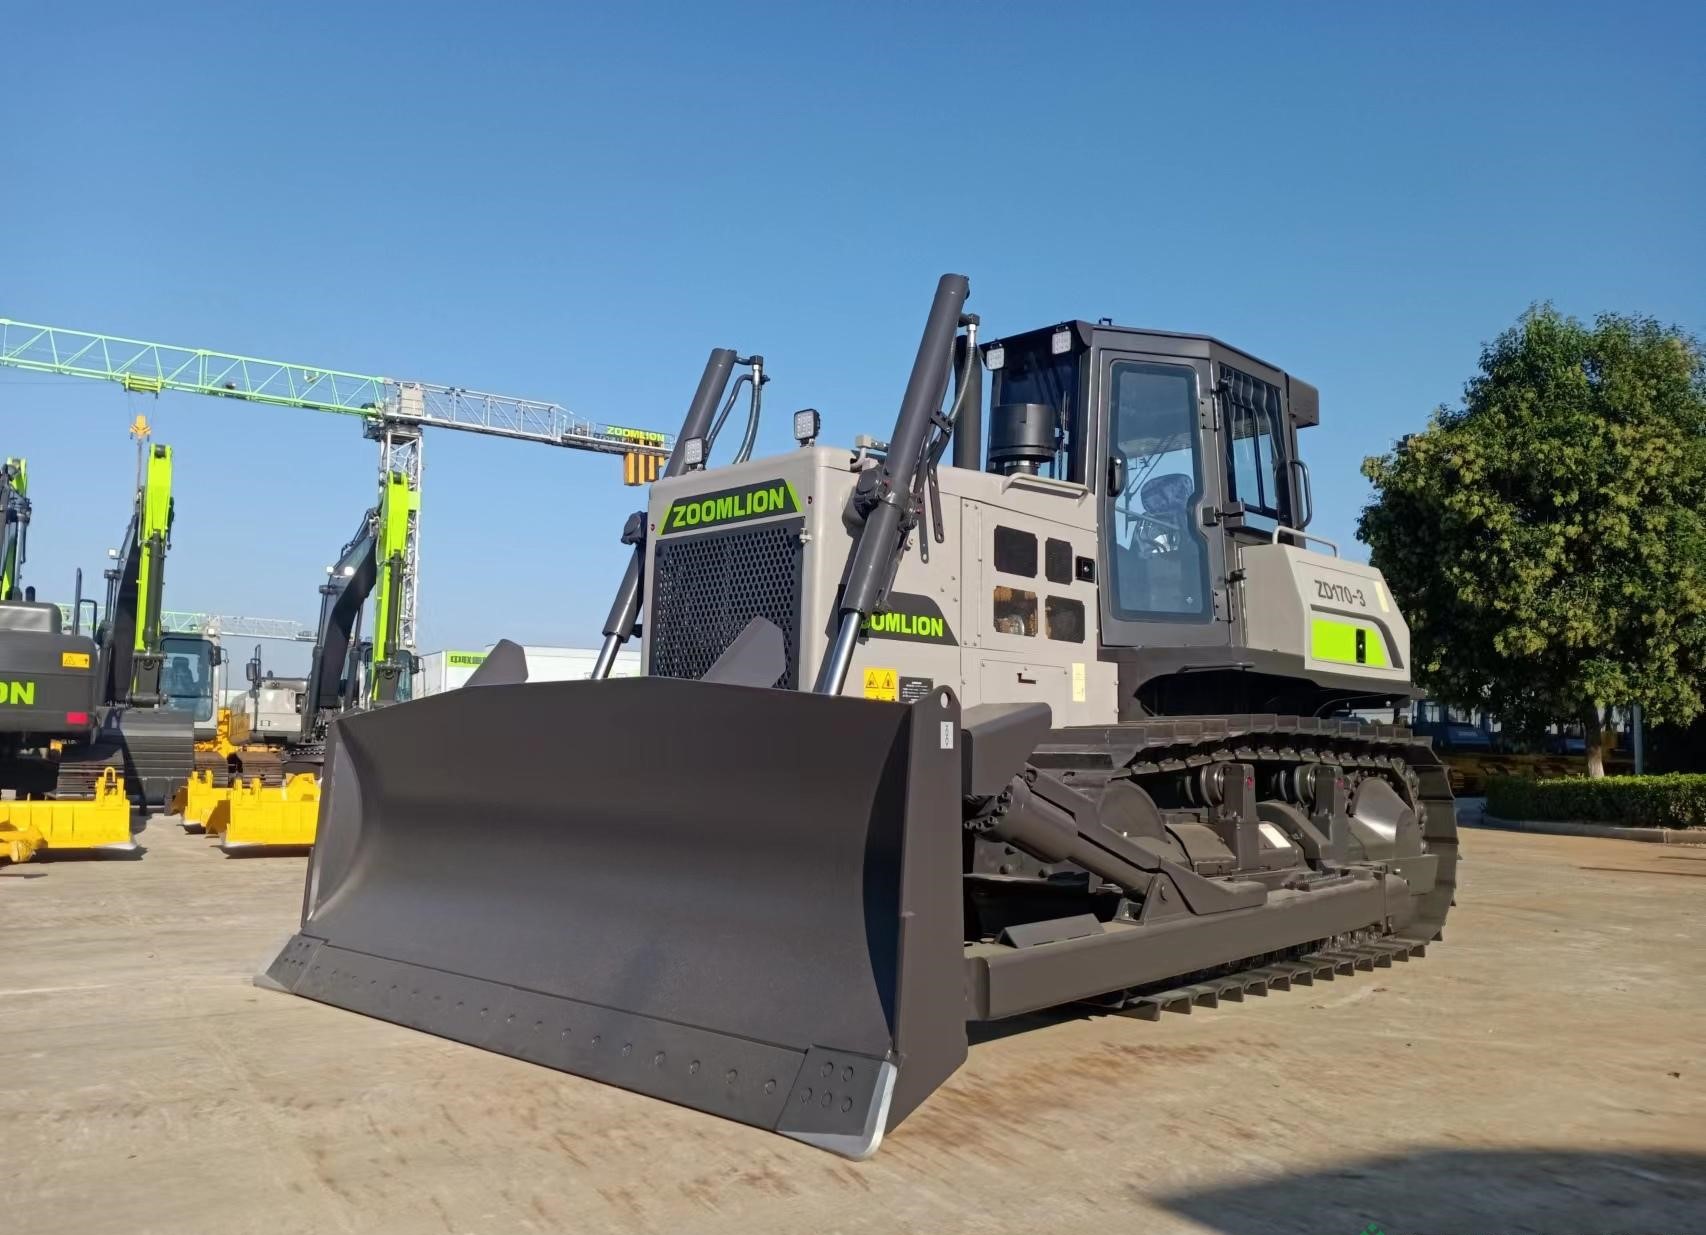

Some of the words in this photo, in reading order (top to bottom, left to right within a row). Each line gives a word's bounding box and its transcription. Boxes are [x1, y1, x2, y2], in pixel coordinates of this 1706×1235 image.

[607, 426, 665, 442] ZOOMLION
[673, 486, 785, 528] ZOOMLION
[1314, 579, 1366, 607] ZD170-3
